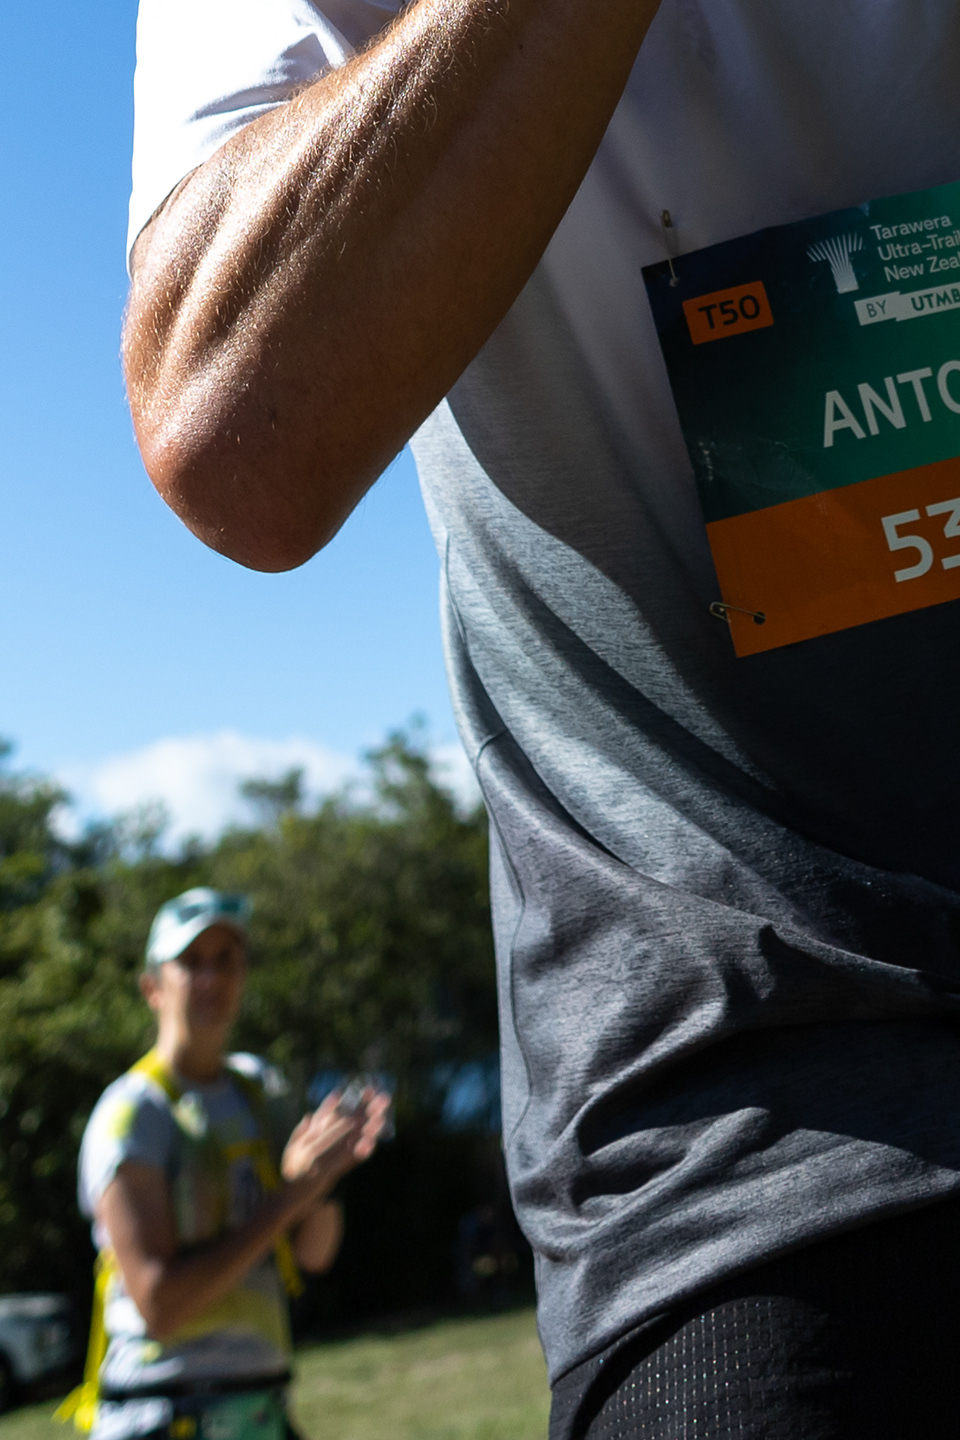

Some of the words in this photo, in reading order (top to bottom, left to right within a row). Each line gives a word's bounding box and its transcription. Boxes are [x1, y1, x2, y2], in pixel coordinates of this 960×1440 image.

[869, 215, 953, 241] Tarawera
[883, 263, 925, 283] New
[697, 292, 761, 331] T50
[866, 300, 887, 318] BY
